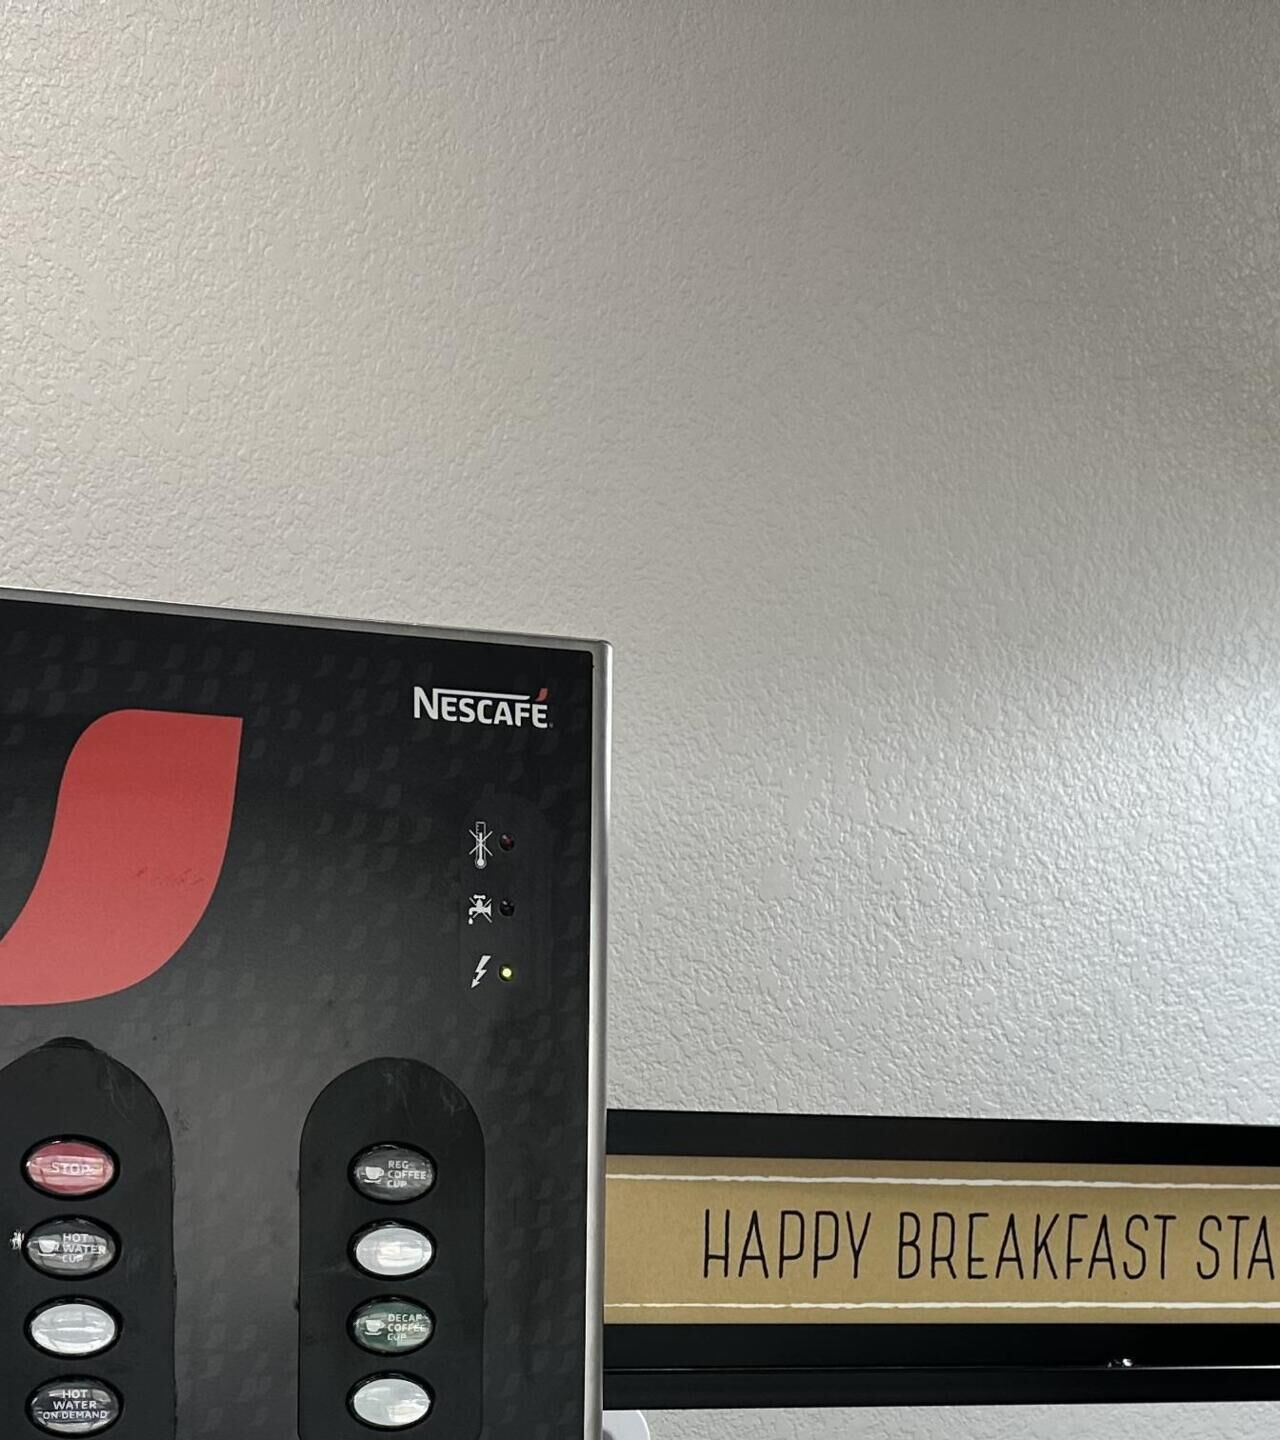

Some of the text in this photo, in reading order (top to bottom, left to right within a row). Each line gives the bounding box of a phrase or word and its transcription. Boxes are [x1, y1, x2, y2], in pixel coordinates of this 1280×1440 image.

[413, 686, 549, 728] NESCAFÉ
[51, 1162, 90, 1175] STOP
[387, 1160, 409, 1169] REG
[387, 1170, 427, 1180] COFFEE
[386, 1180, 408, 1189] CUP
[62, 1232, 88, 1243] HOT
[62, 1243, 107, 1255] WATER
[703, 1208, 872, 1279] HAPPY
[897, 1211, 1177, 1280] BREAKFAST
[62, 1253, 84, 1263] CUP
[387, 1313, 423, 1322] DECAF
[387, 1323, 427, 1333] COFFEE
[386, 1333, 408, 1341] CUP
[62, 1389, 89, 1399] HOT
[53, 1400, 98, 1411] WATER
[42, 1410, 108, 1420] ON DEMAND
